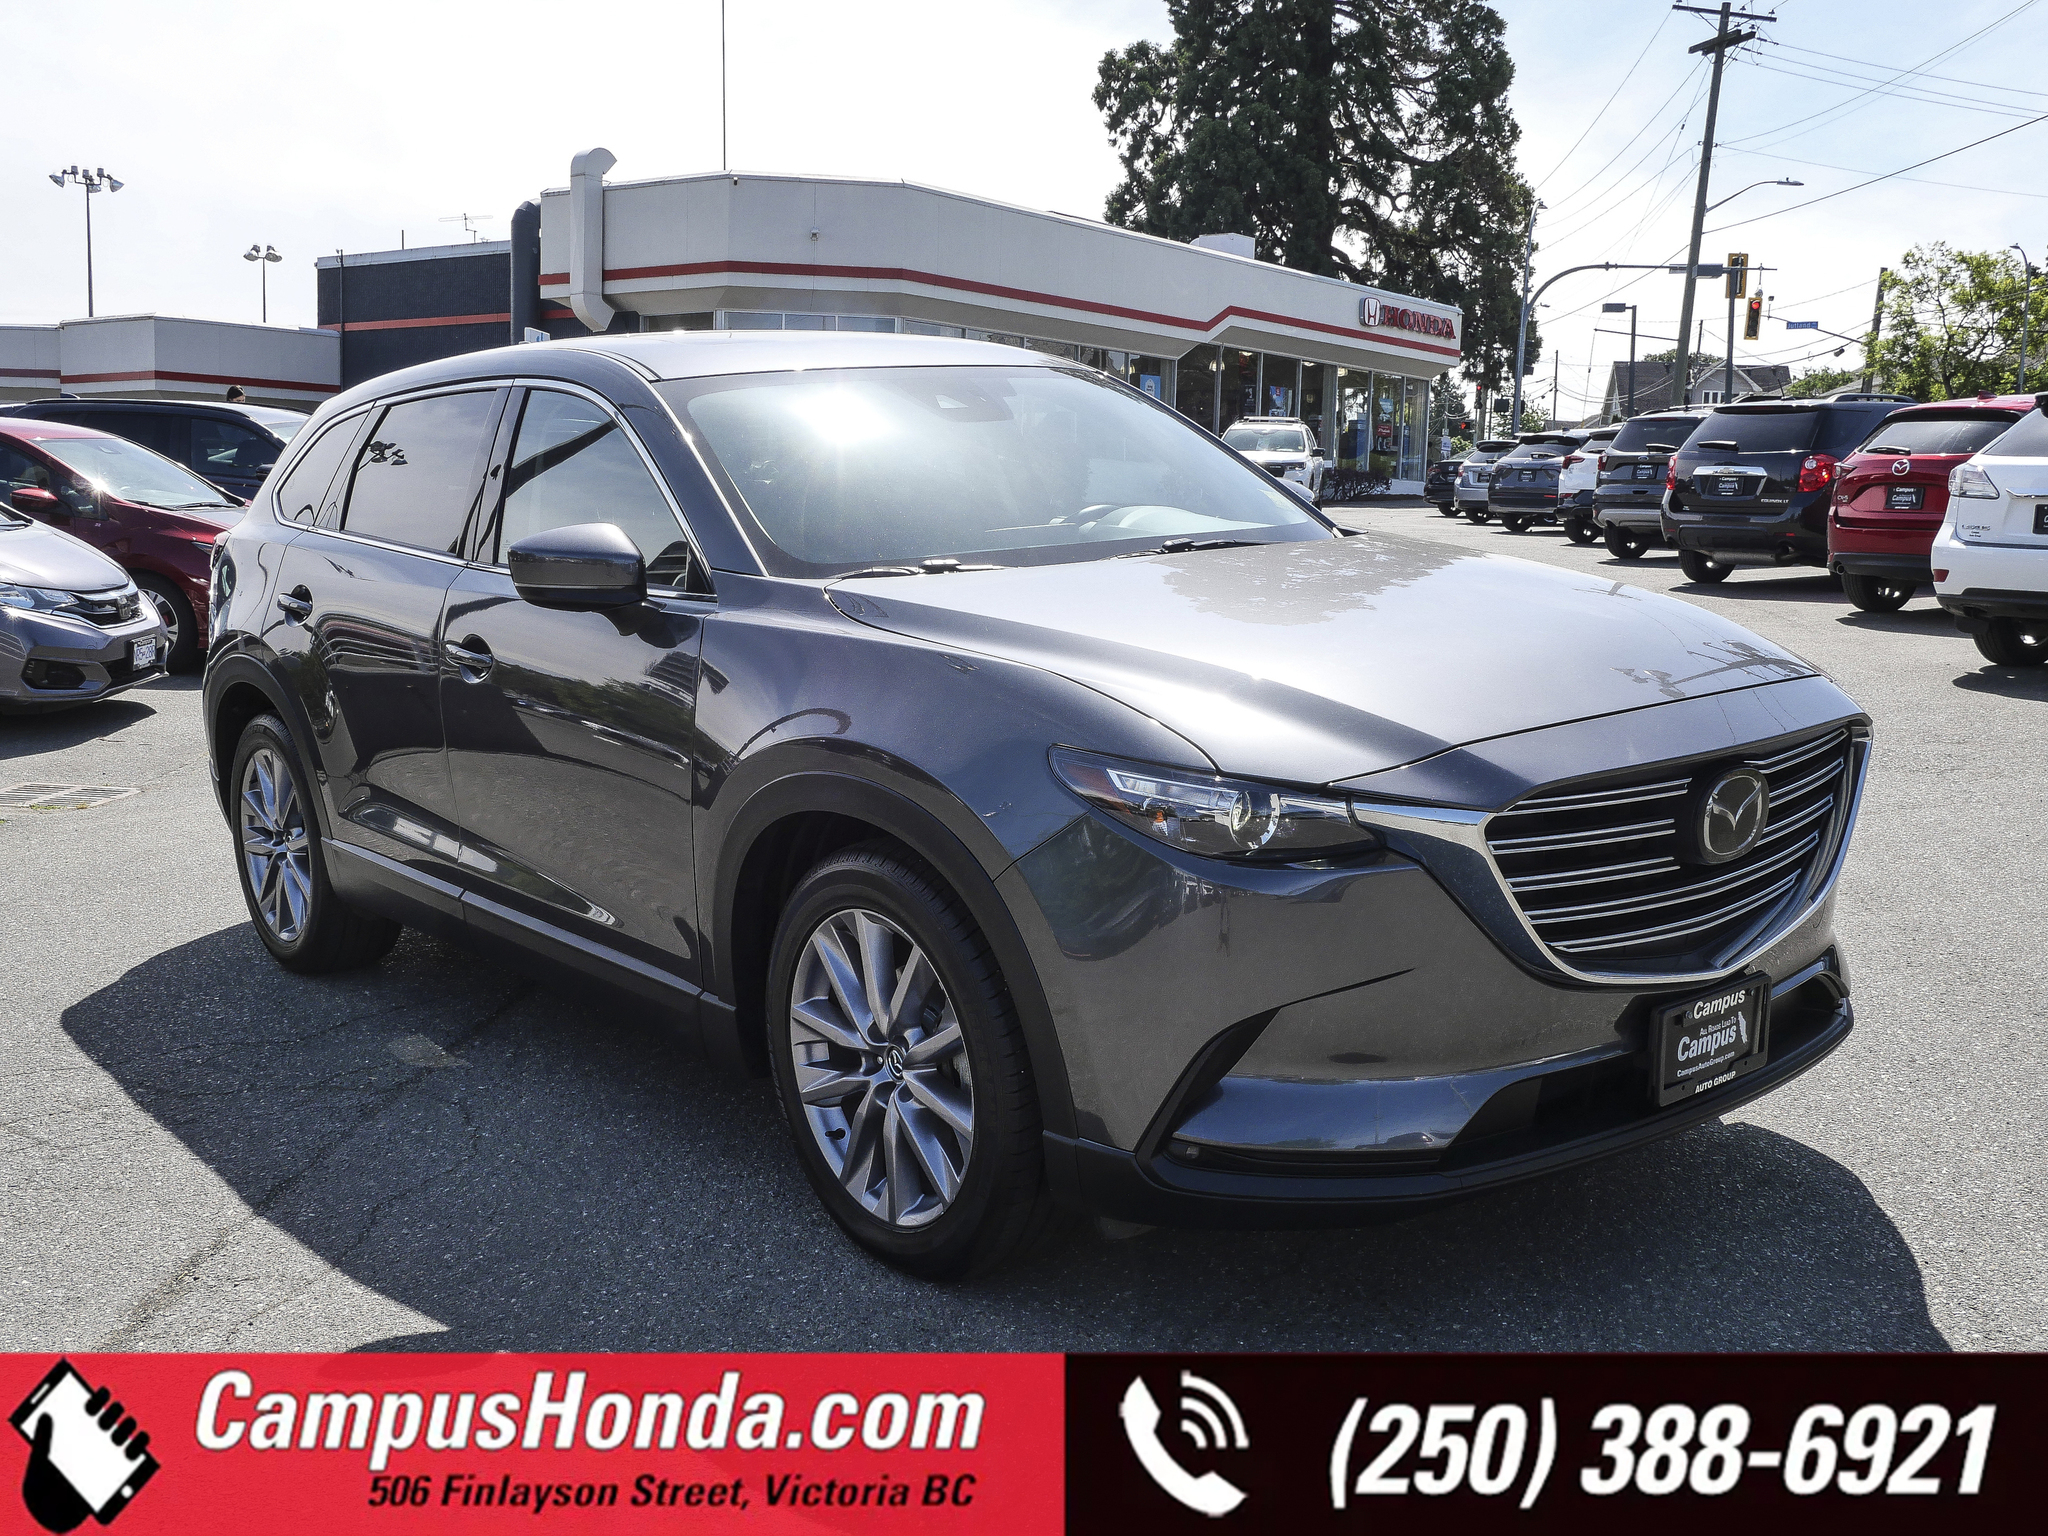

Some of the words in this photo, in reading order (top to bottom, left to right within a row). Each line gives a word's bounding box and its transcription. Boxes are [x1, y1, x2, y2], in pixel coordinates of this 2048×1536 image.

[1381, 304, 1456, 339] HONDA
[1693, 989, 1746, 1019] Campus
[1677, 1025, 1737, 1061] Campus
[1677, 1051, 1735, 1077] CampusAutoGroup.com
[1694, 1079, 1713, 1094] AUTO
[1713, 1070, 1736, 1086] GROUP
